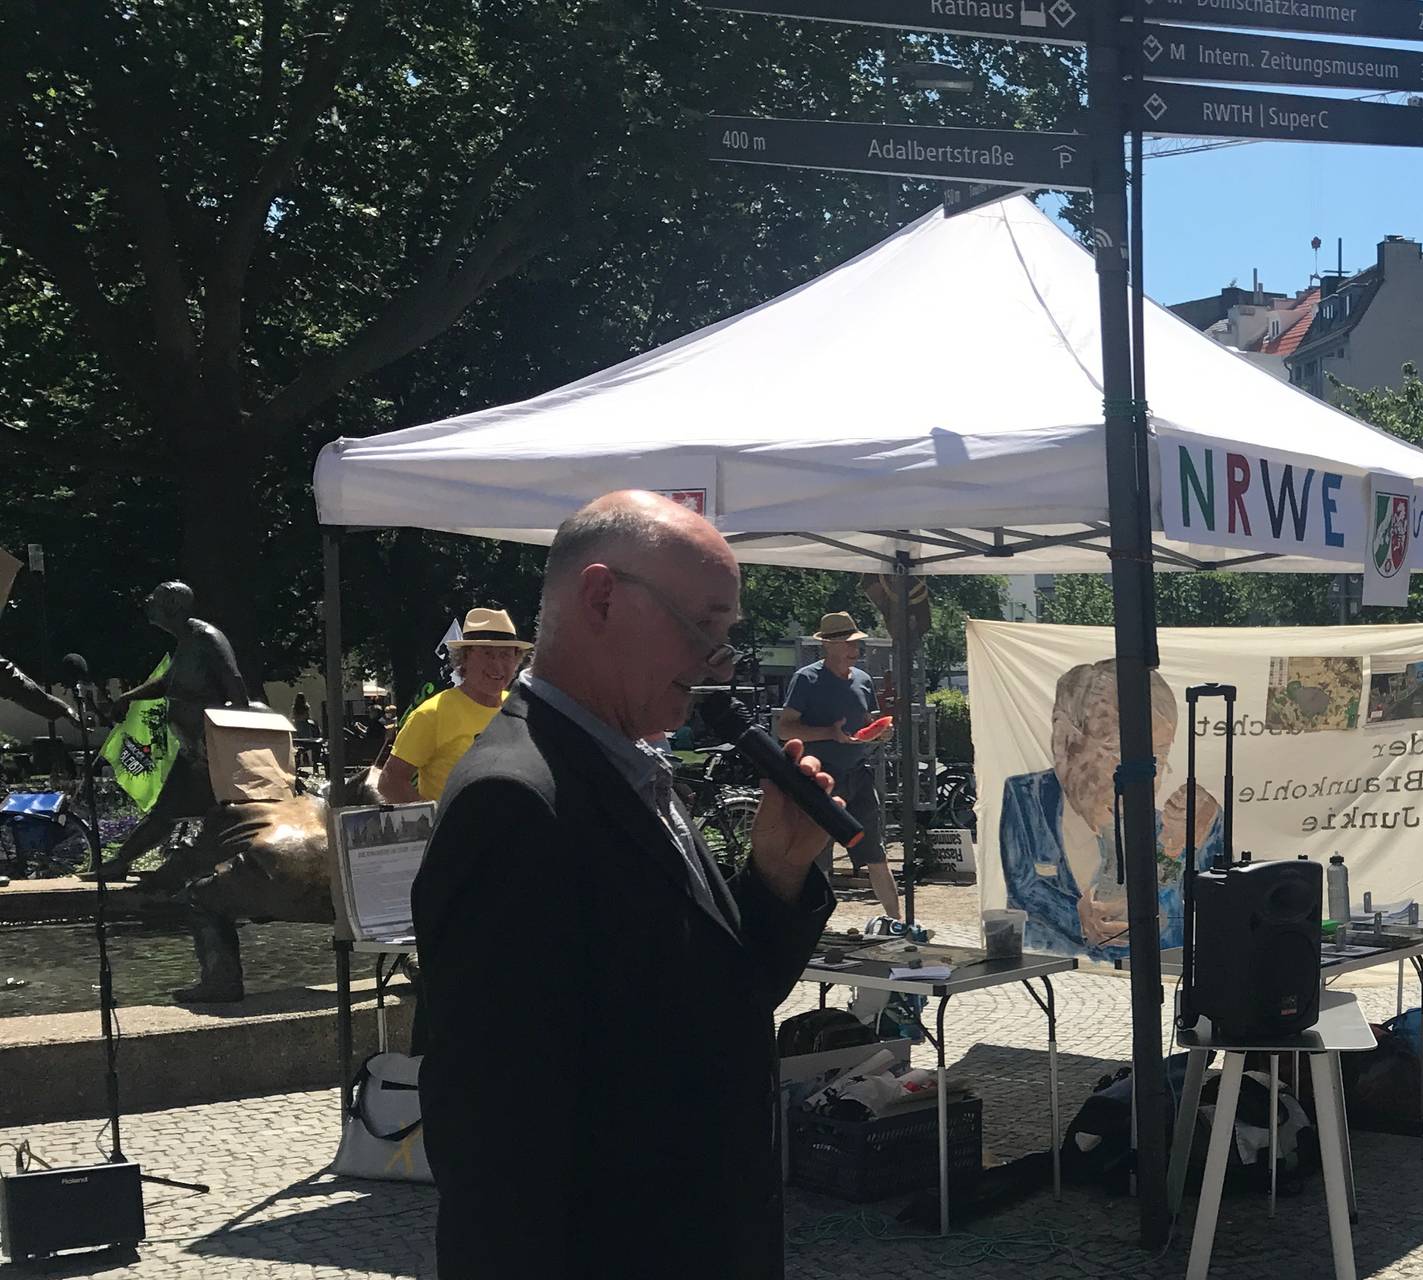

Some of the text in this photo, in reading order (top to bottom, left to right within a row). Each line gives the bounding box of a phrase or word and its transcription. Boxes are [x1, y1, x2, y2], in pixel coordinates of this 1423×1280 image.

[931, 0, 1014, 19] Rathaus
[1170, 44, 1185, 61] M
[1199, 44, 1254, 68] Intern.
[1260, 50, 1399, 79] Zeitungsmuseum
[1203, 103, 1253, 124] RWTH
[722, 129, 749, 149] 400
[752, 137, 767, 152] m
[867, 138, 1015, 166] Adalbertstraße
[1178, 444, 1345, 548] NRWE
